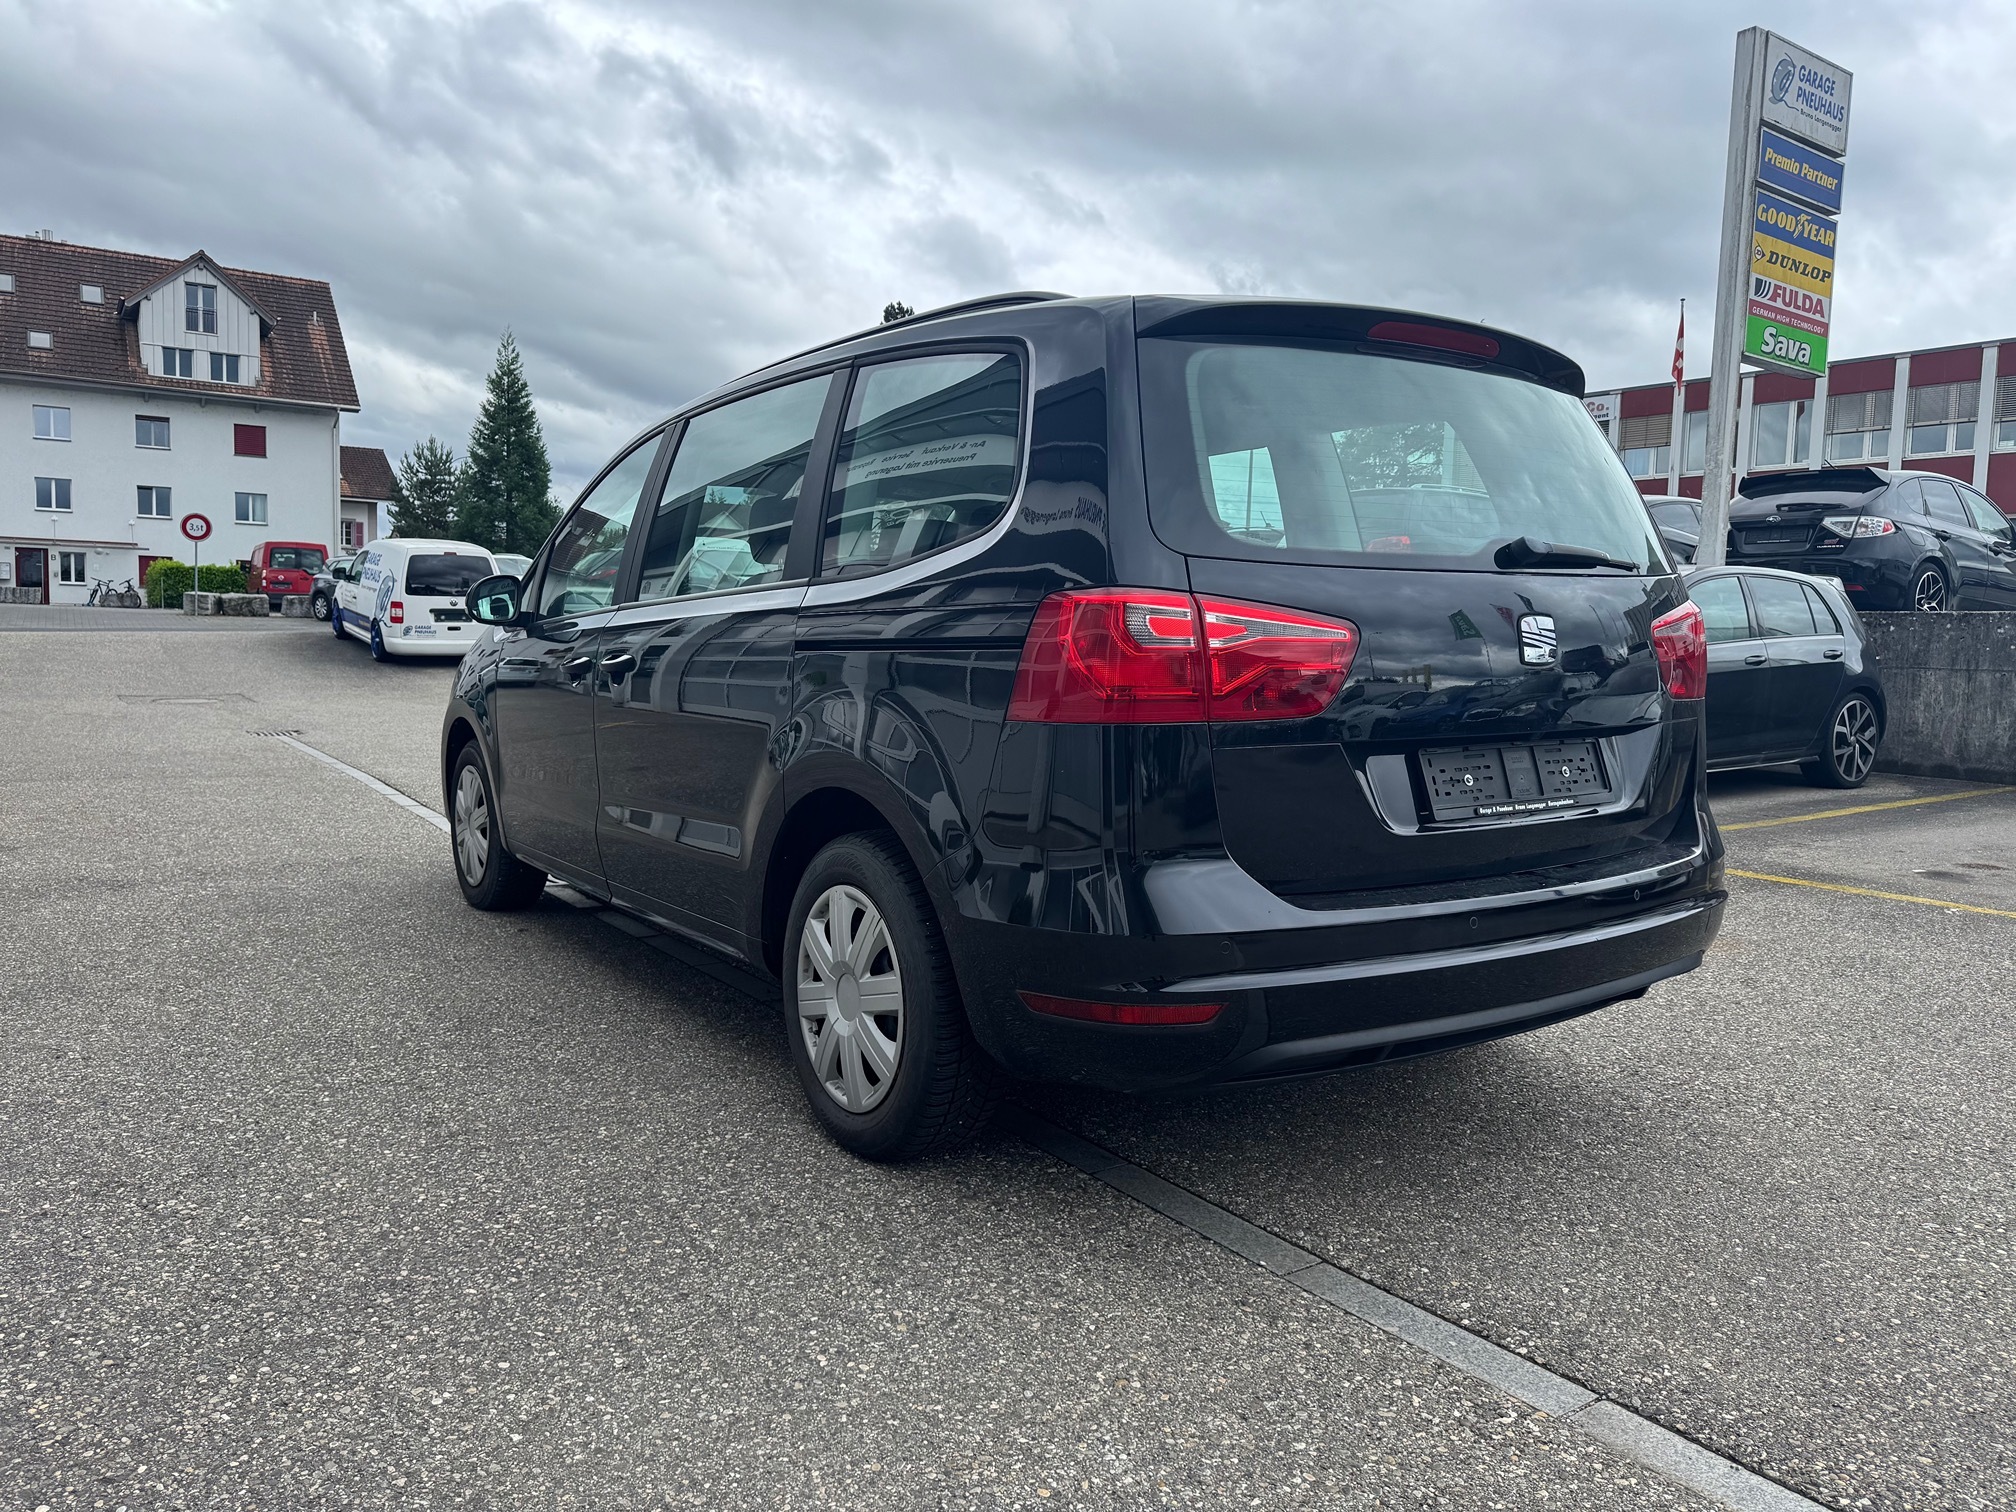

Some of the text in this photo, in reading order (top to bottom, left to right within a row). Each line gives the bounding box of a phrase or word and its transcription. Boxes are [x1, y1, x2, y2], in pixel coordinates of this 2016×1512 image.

[1798, 64, 1836, 97] GARAGE
[1796, 86, 1845, 123] PNEUHAUS
[1800, 108, 1814, 120] Bruno
[1765, 147, 1838, 190] Premio Partner
[1767, 250, 1832, 283] DUNLOP
[1767, 284, 1825, 318] FULDA
[1752, 306, 1825, 334] GERMAN HIGH TECHNOLOGY
[1760, 325, 1812, 365] Sava
